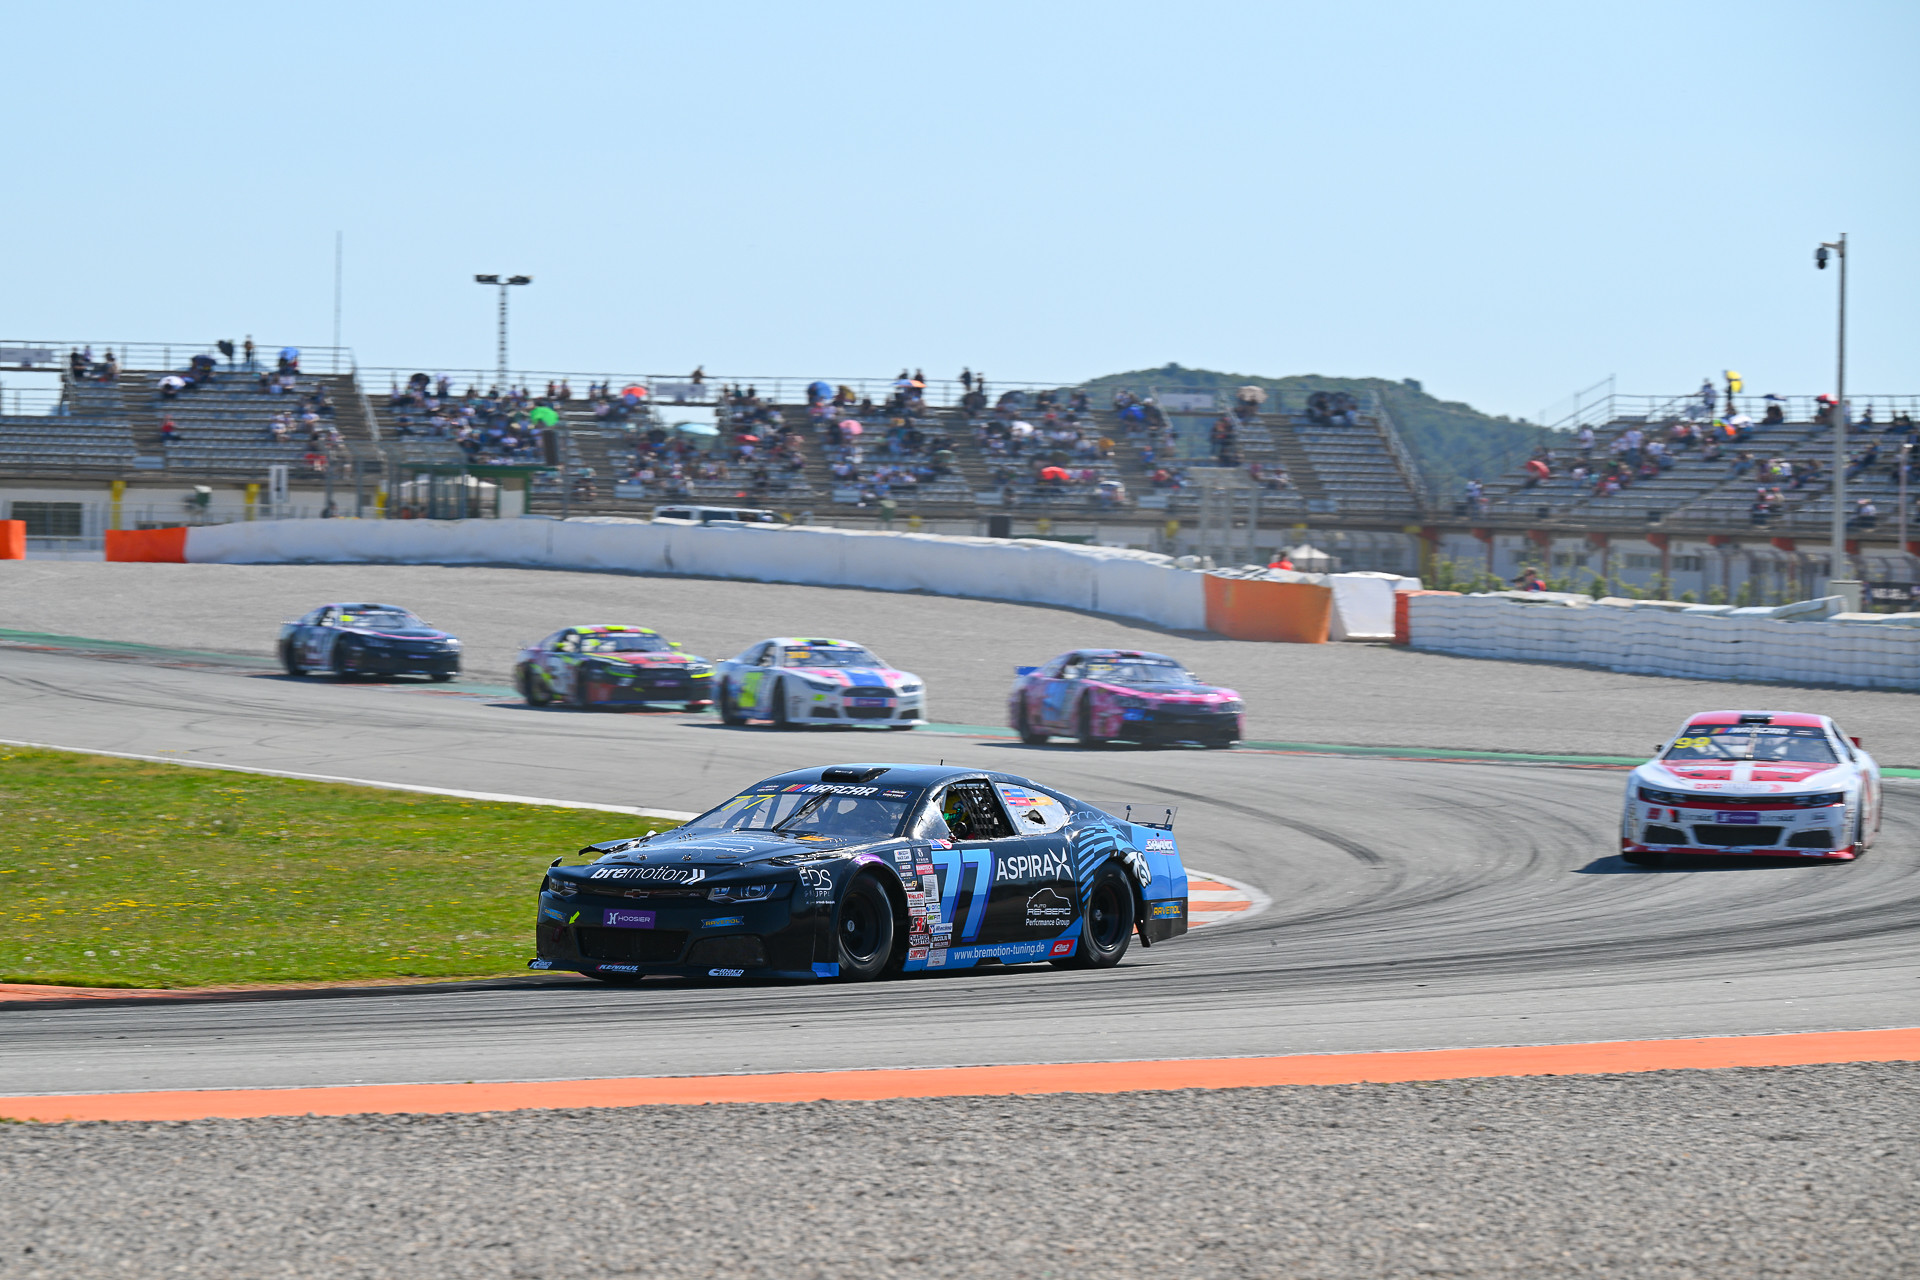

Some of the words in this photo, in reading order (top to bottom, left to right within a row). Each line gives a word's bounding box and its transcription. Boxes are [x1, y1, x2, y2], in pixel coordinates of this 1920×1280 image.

[1674, 737, 1712, 748] 99
[802, 784, 878, 796] NASCAR
[590, 866, 688, 882] bremotion
[931, 849, 996, 942] 77
[1153, 905, 1181, 916] RAVENOL
[705, 918, 741, 926] RAVENOL
[1026, 918, 1055, 926] Performance
[1056, 918, 1070, 927] Group
[954, 941, 1045, 961] www.bremotion-tuning.de
